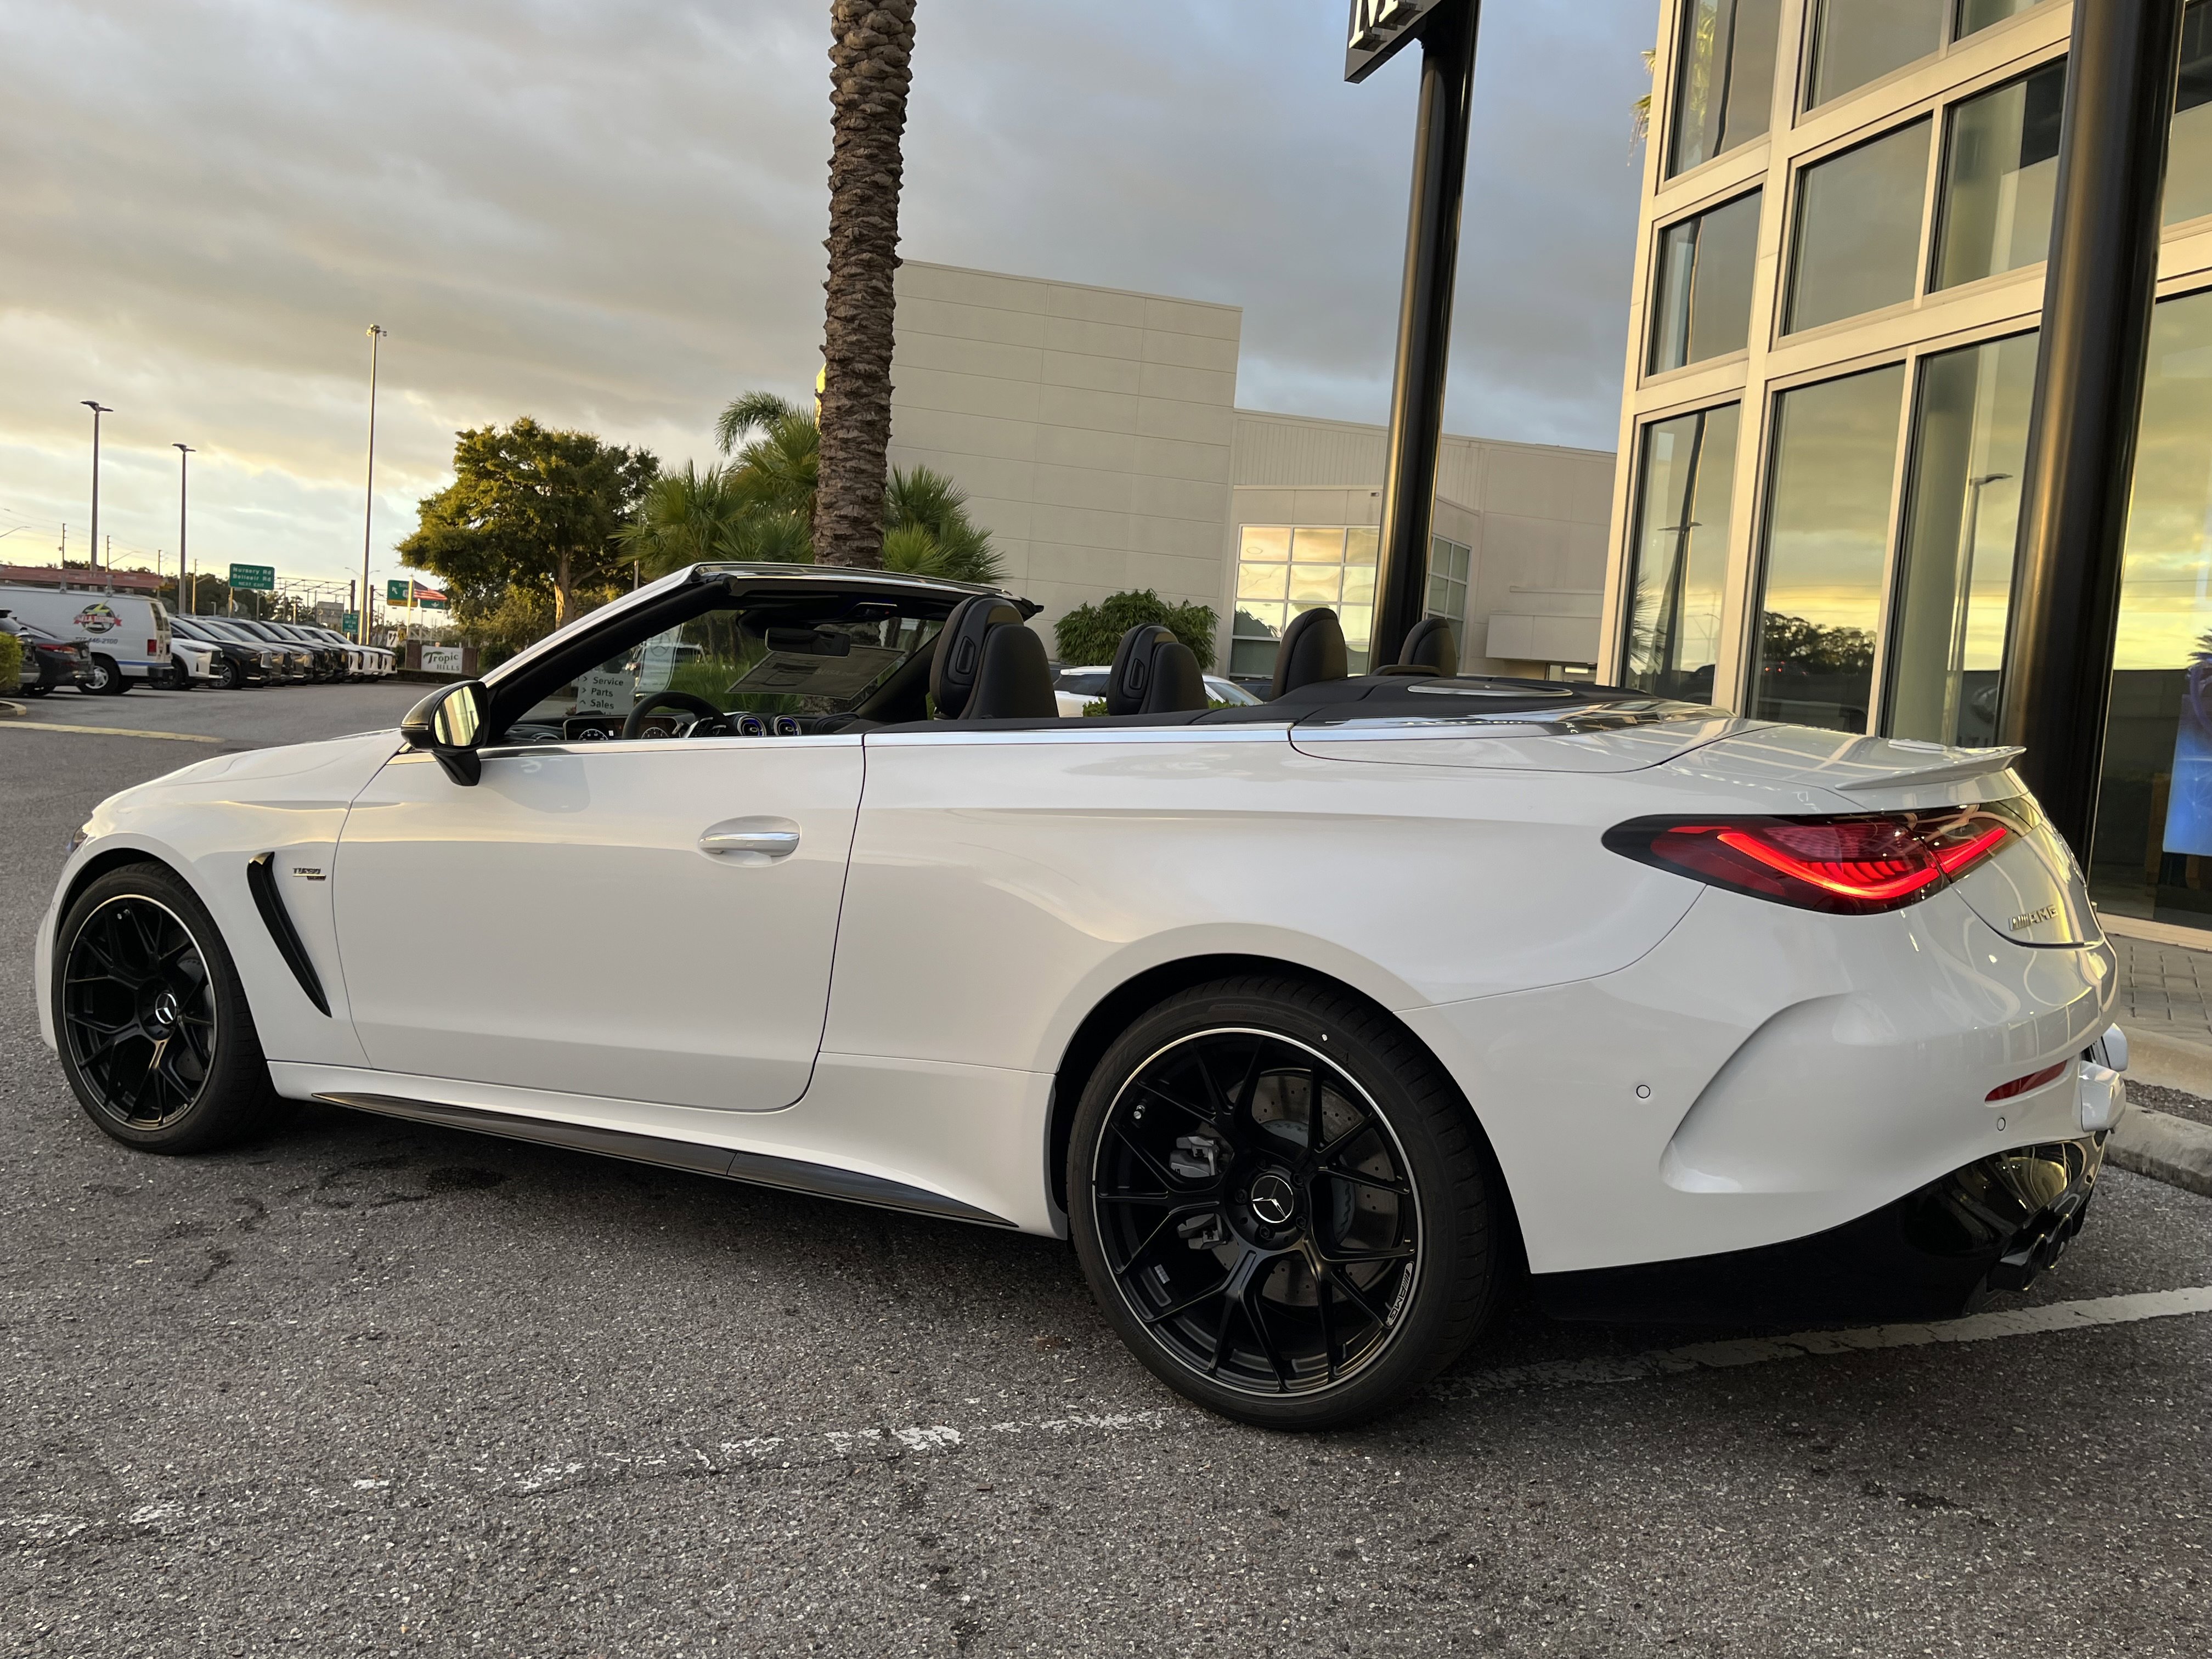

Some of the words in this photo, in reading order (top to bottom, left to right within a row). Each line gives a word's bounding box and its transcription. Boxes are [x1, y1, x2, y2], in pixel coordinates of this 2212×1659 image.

[233, 567, 259, 575] Nursery
[423, 651, 459, 664] Tropic
[593, 676, 624, 686] Service
[591, 688, 613, 697] Parts
[590, 699, 614, 709] Sales
